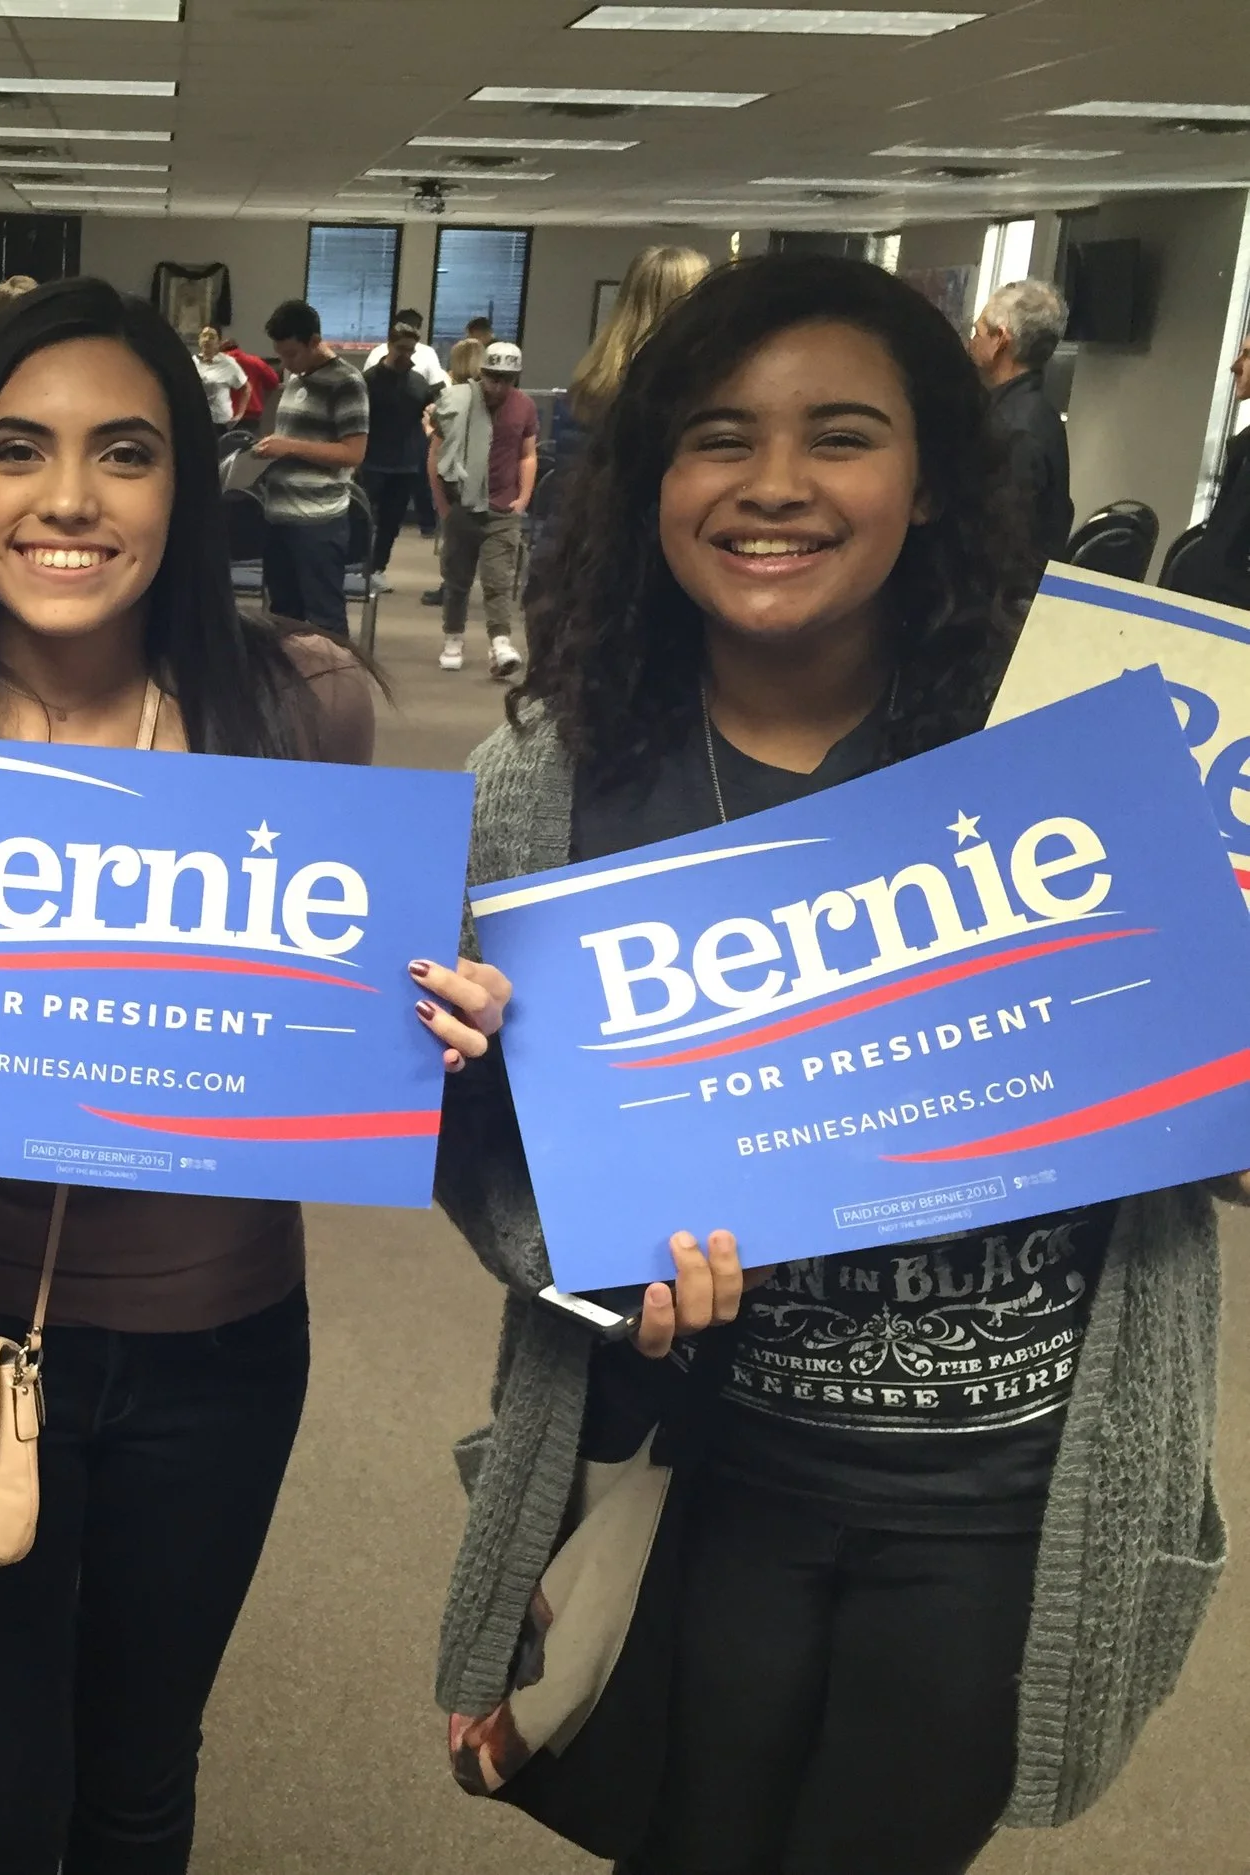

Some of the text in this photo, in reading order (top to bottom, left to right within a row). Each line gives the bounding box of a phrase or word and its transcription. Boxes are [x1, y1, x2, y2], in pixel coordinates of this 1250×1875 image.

[579, 809, 1113, 1036] Bernie
[43, 993, 273, 1037] PRESIDENT
[699, 996, 1054, 1104] FOR PRESIDENT
[735, 1070, 1055, 1157] BERNIESANDERS.COM
[31, 1144, 57, 1156] PAID
[57, 1147, 80, 1159] FOR
[81, 1148, 97, 1160] BY
[97, 1150, 136, 1165] BERNIE
[138, 1154, 165, 1167] 2016
[842, 1183, 997, 1223] PAID FOR BY BERNIE 2016
[935, 1357, 983, 1377] THE
[963, 1357, 1074, 1406] THRE
